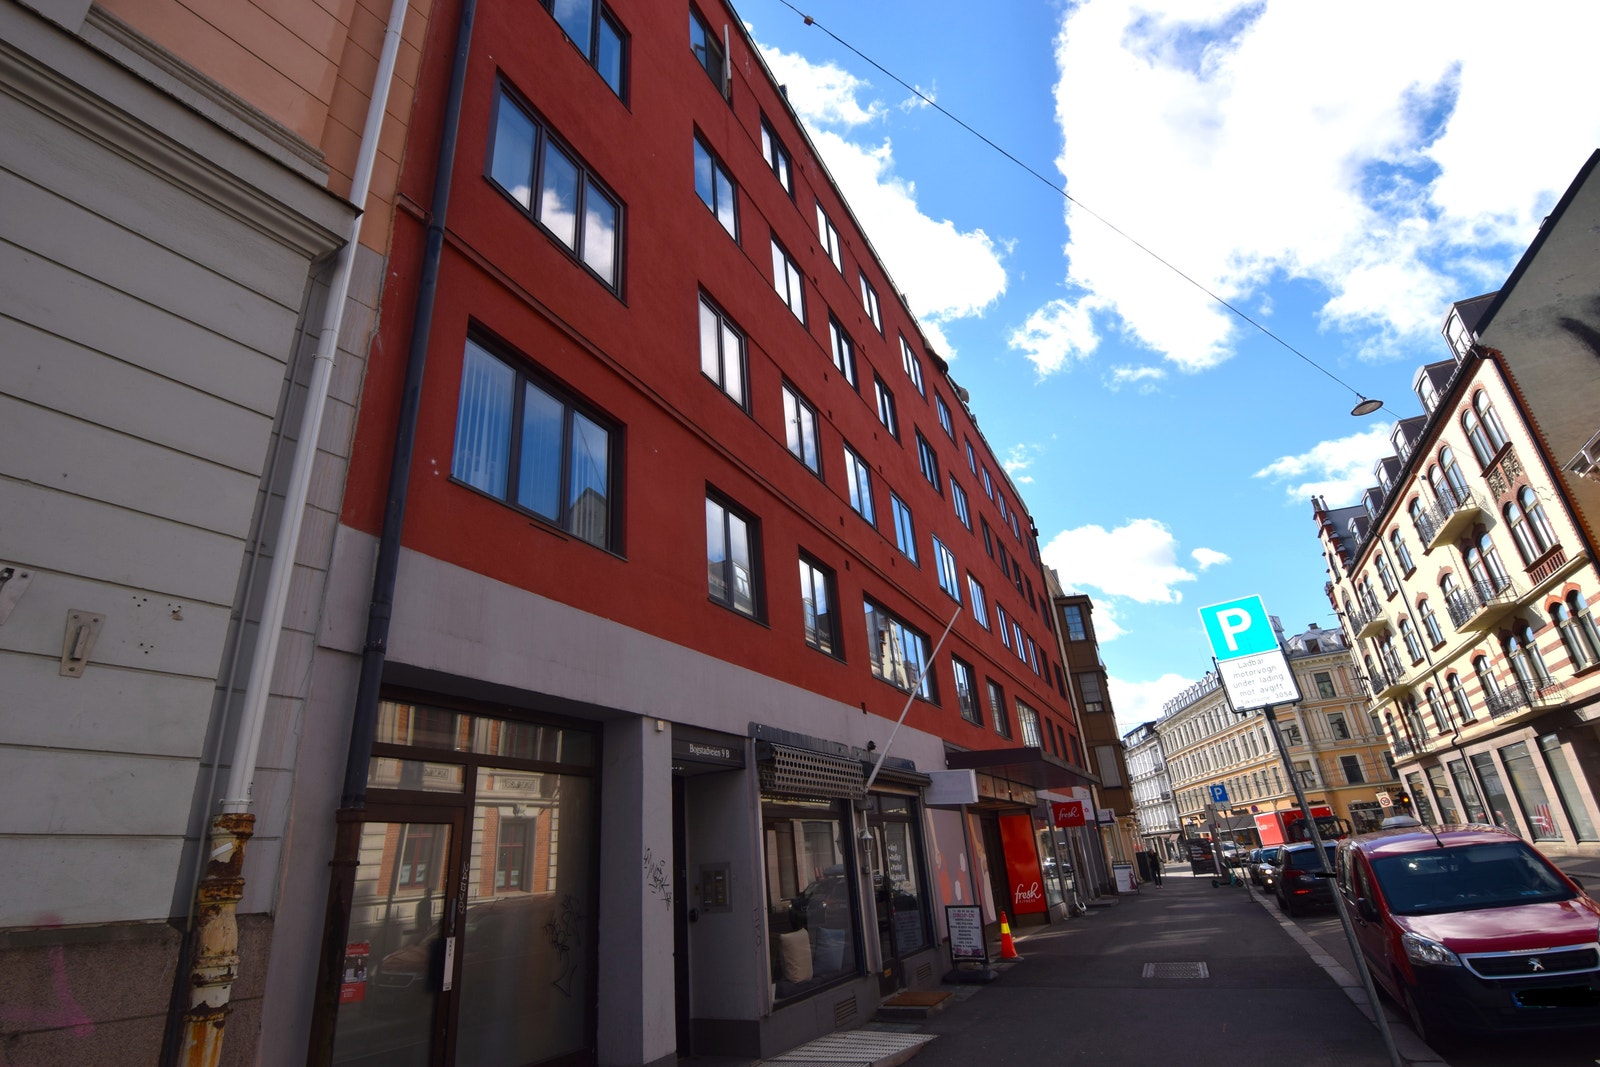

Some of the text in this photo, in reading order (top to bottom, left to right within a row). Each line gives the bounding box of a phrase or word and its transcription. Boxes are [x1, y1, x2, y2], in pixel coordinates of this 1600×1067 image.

[1215, 607, 1252, 652] P
[1237, 658, 1264, 669] Ladbar
[1233, 665, 1277, 679] motorvogn
[1232, 673, 1284, 689] under lading
[1239, 683, 1284, 697] mot avgift
[689, 743, 721, 757] Bogstadveien
[1213, 787, 1223, 800] P
[1058, 806, 1080, 821] fresh
[1014, 881, 1042, 904] fresh
